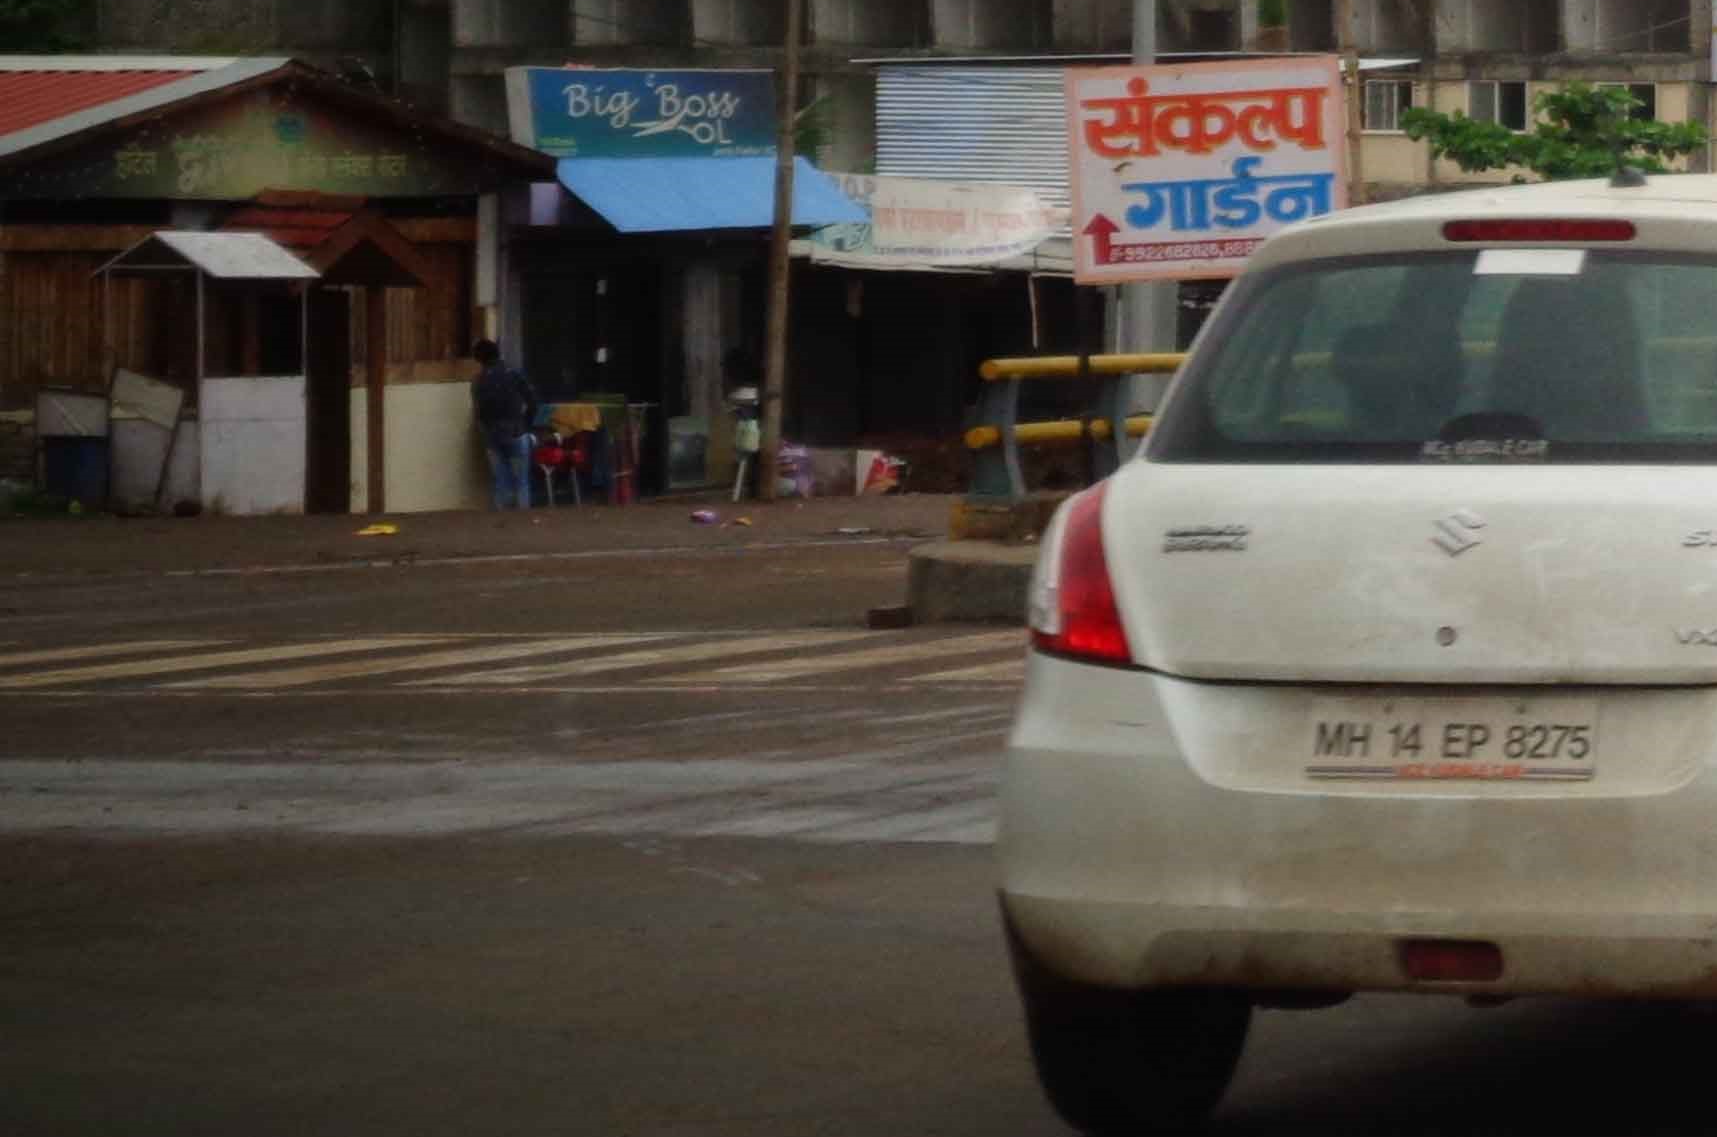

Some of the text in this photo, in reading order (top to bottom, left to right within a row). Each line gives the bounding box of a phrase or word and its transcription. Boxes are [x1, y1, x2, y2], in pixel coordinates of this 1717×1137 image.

[562, 83, 742, 129] Big Boss
[1080, 76, 1328, 158] संकल्प
[1121, 156, 1335, 230] गार्डन
[1314, 722, 1591, 760] MH 14 EP 8275
